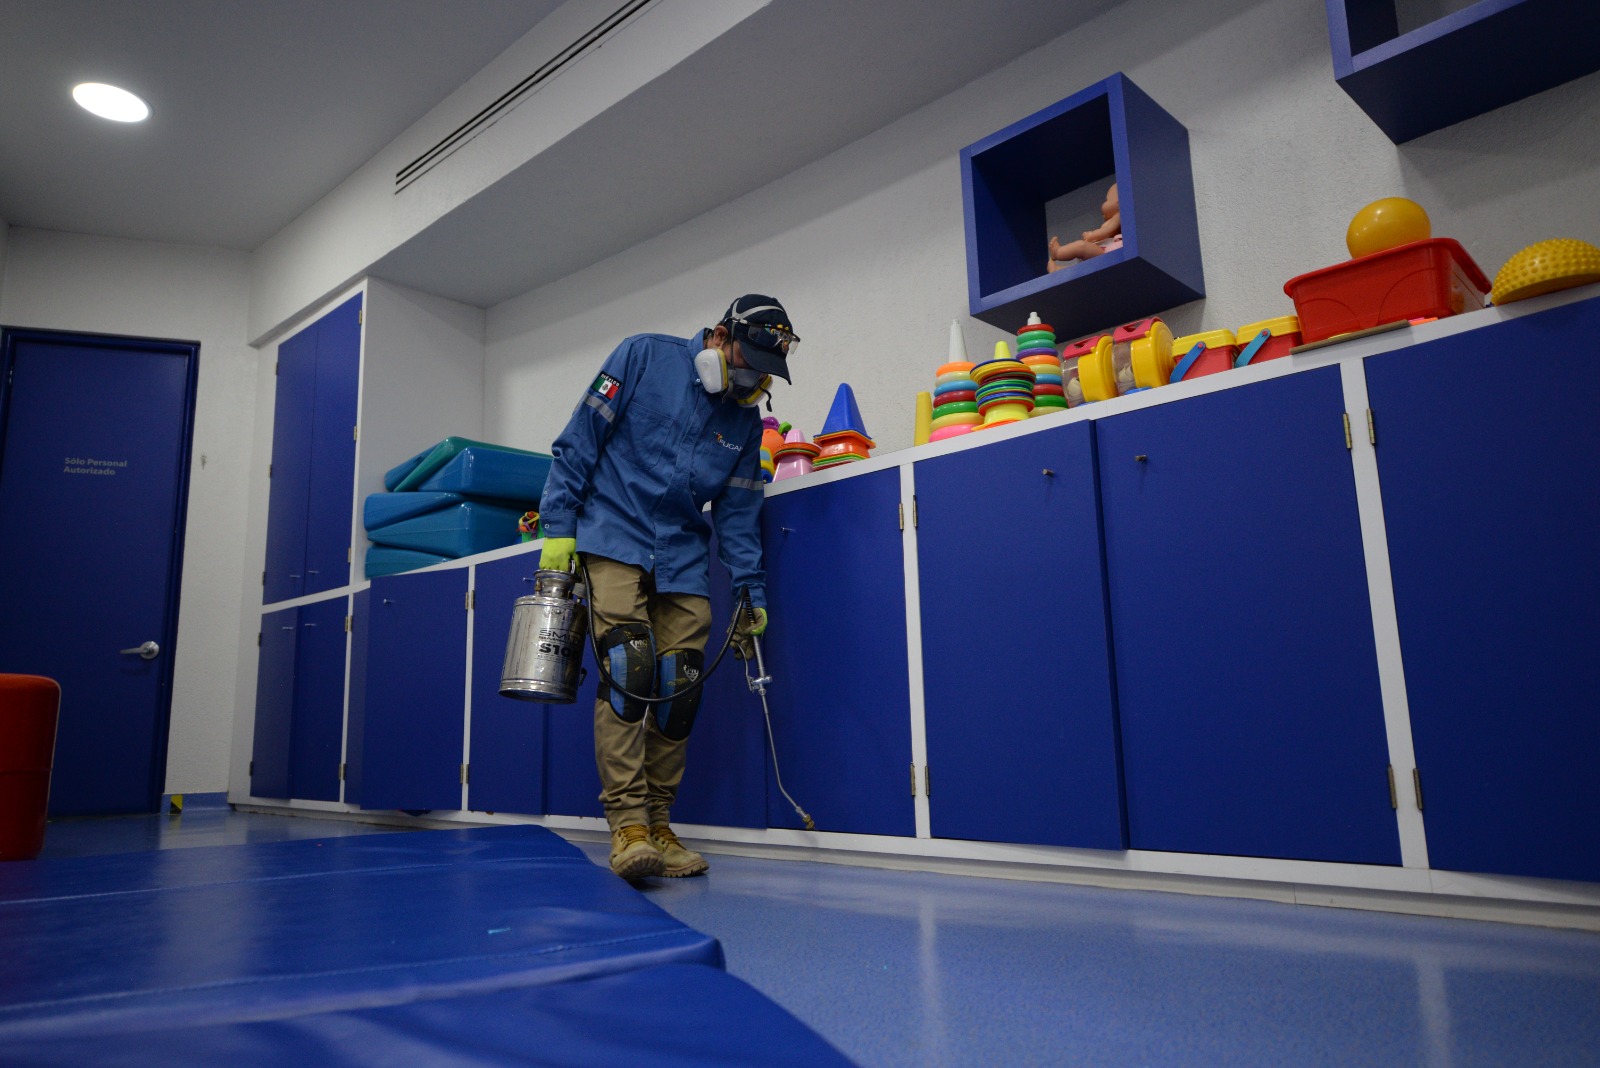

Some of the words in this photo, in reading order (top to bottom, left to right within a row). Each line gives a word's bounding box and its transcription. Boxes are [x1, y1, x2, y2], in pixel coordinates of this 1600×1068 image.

[64, 456, 86, 465] Sólo
[87, 458, 128, 468] Personal
[63, 465, 116, 476] Autorizado
